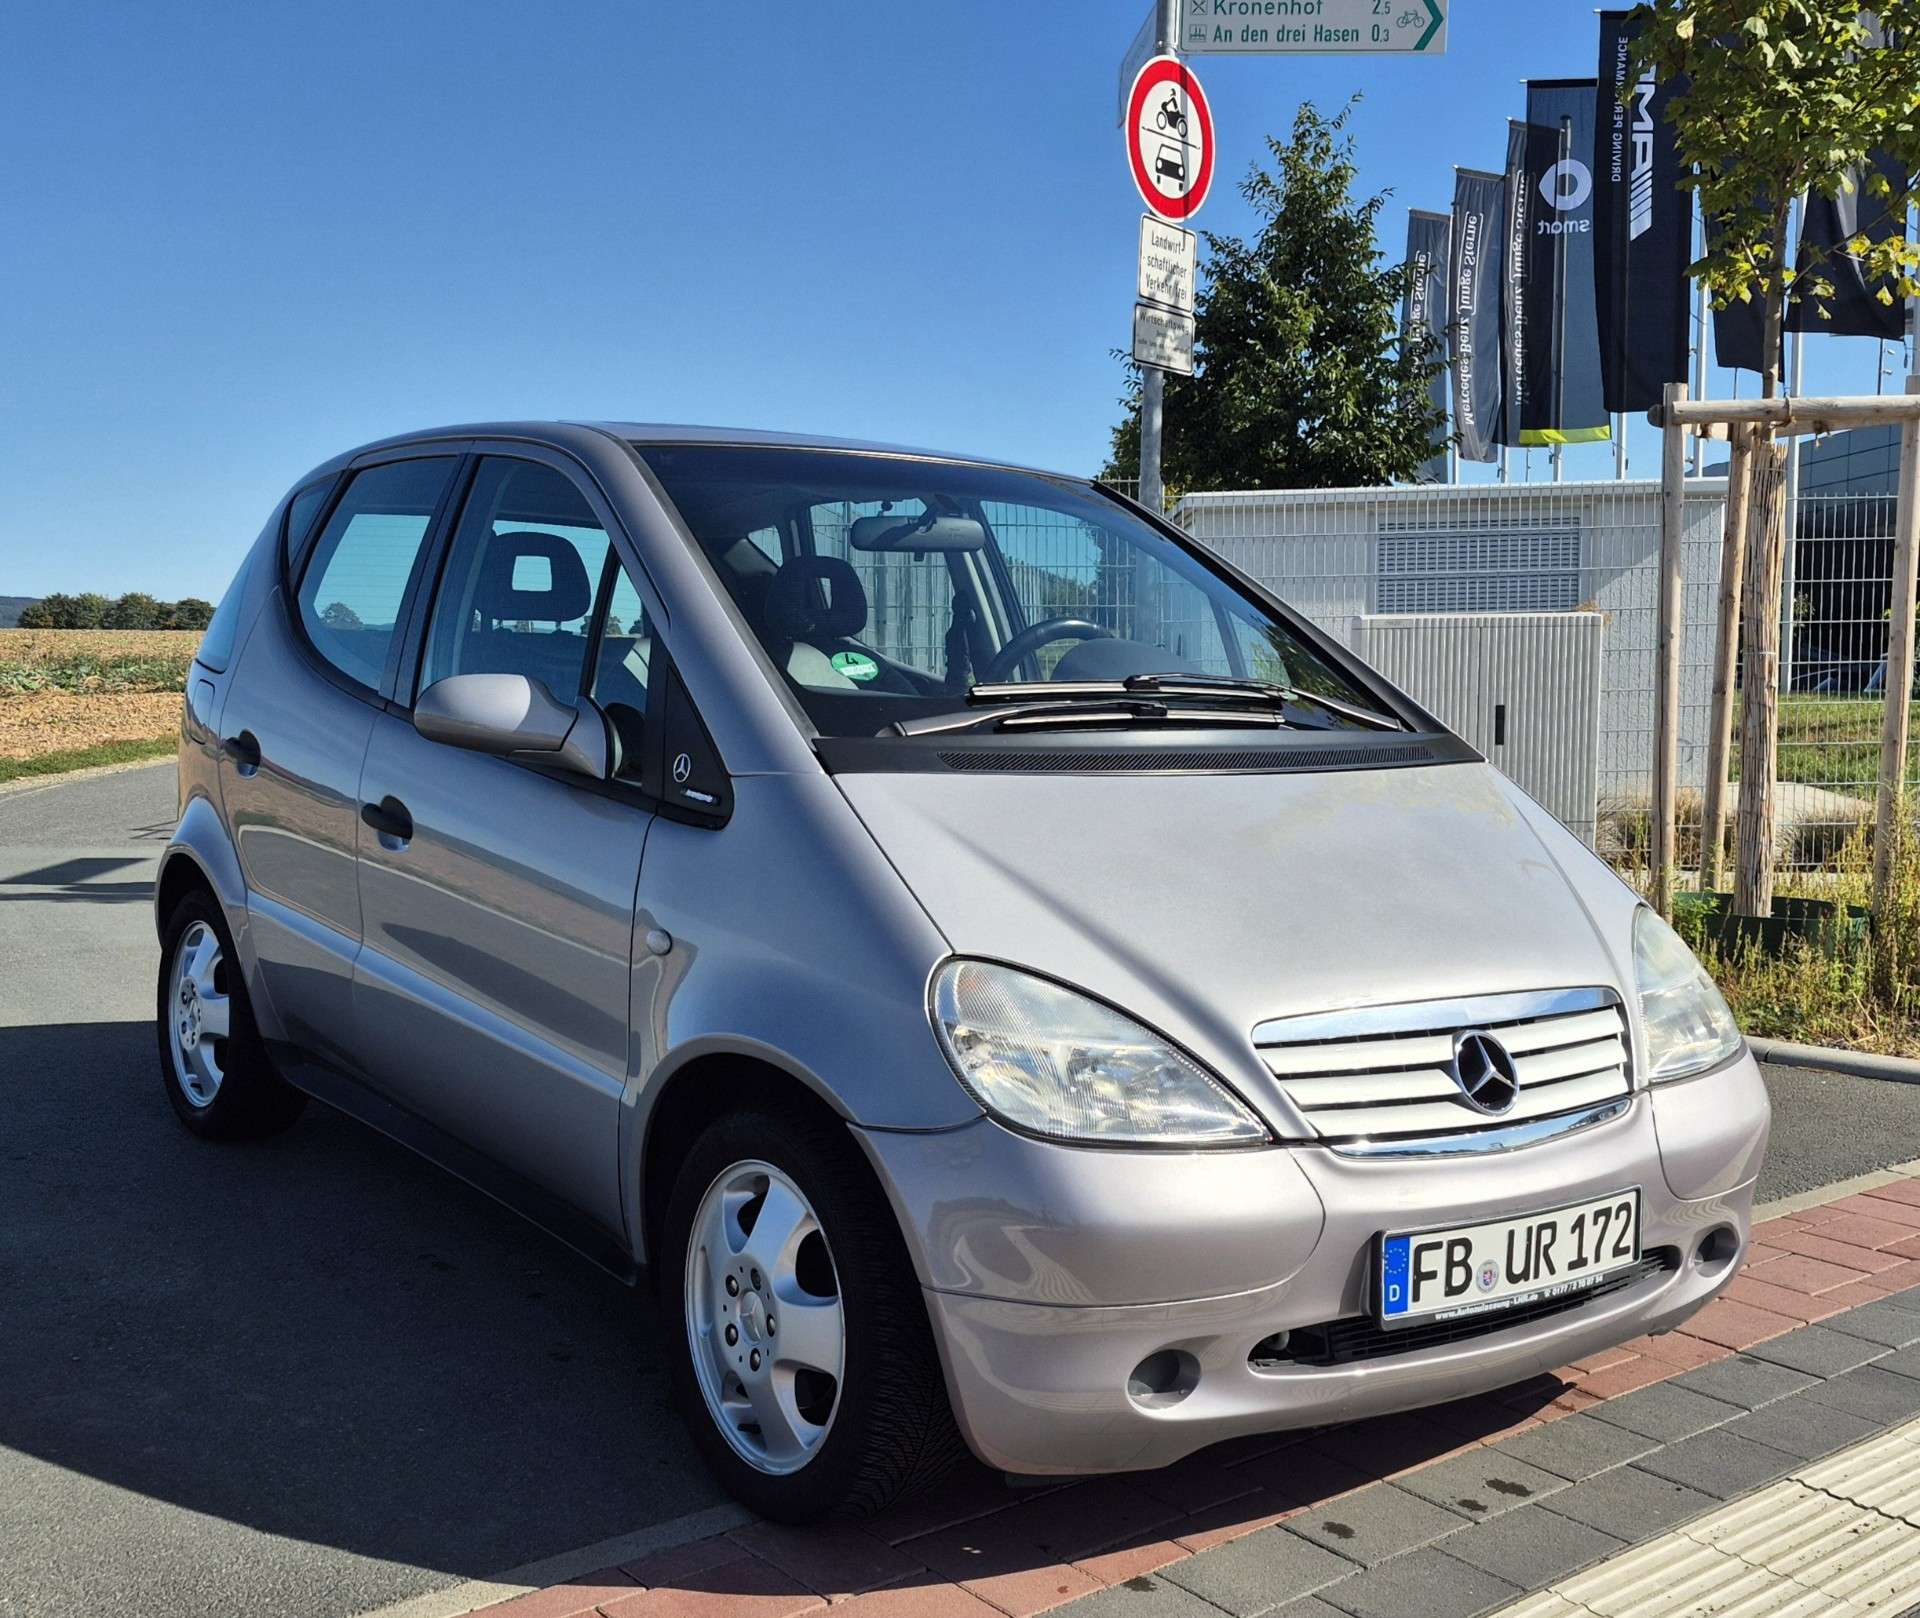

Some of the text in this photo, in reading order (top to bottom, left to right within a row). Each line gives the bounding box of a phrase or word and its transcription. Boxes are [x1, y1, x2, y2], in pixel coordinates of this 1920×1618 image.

[1213, 0, 1323, 15] Kronenhof
[1213, 25, 1233, 42] An
[1241, 24, 1268, 42] den
[1276, 24, 1306, 42] drei
[1313, 24, 1360, 42] Hasen
[845, 653, 858, 665] 4
[1412, 1201, 1632, 1303] FB UR 172
[1389, 1284, 1400, 1302] D
